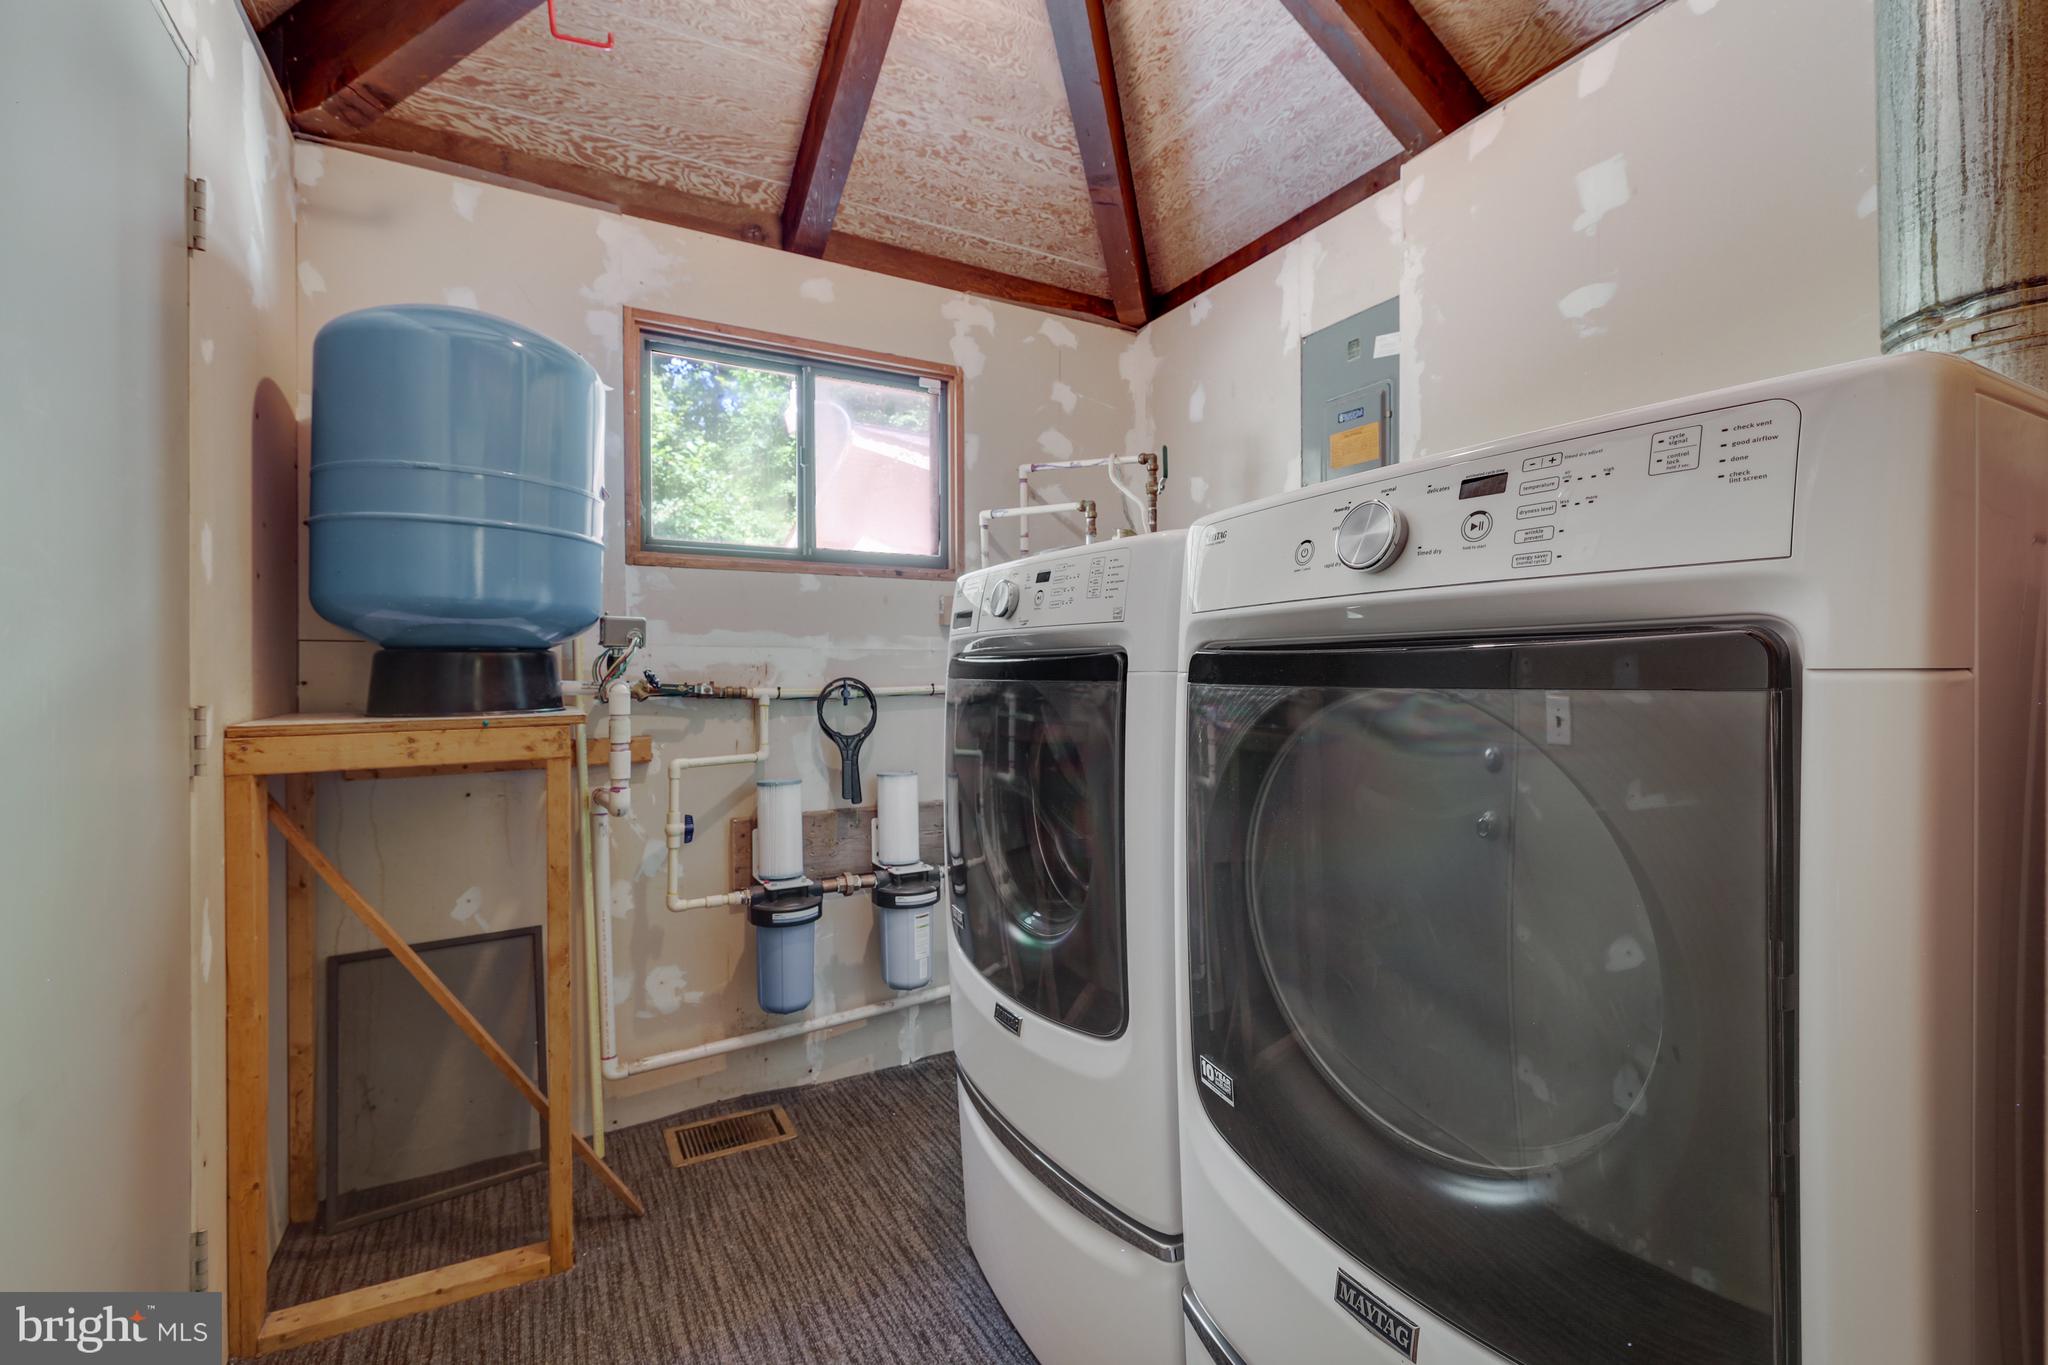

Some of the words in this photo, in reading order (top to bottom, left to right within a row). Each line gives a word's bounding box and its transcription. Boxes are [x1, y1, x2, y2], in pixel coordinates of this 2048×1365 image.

[1733, 423, 1755, 432] check
[1756, 419, 1773, 428] vent
[1668, 432, 1686, 441] cycle
[1668, 437, 1689, 447] signal
[1731, 438, 1751, 448] good
[1752, 434, 1779, 444] airflow
[1666, 450, 1690, 460] control
[1730, 454, 1750, 463] done
[1729, 469, 1751, 478] check
[1729, 476, 1742, 485] lint
[1743, 473, 1768, 482] screen
[1522, 480, 1556, 492] temperature
[1201, 1059, 1215, 1082] 10
[1338, 1280, 1410, 1348] MAYTAG
